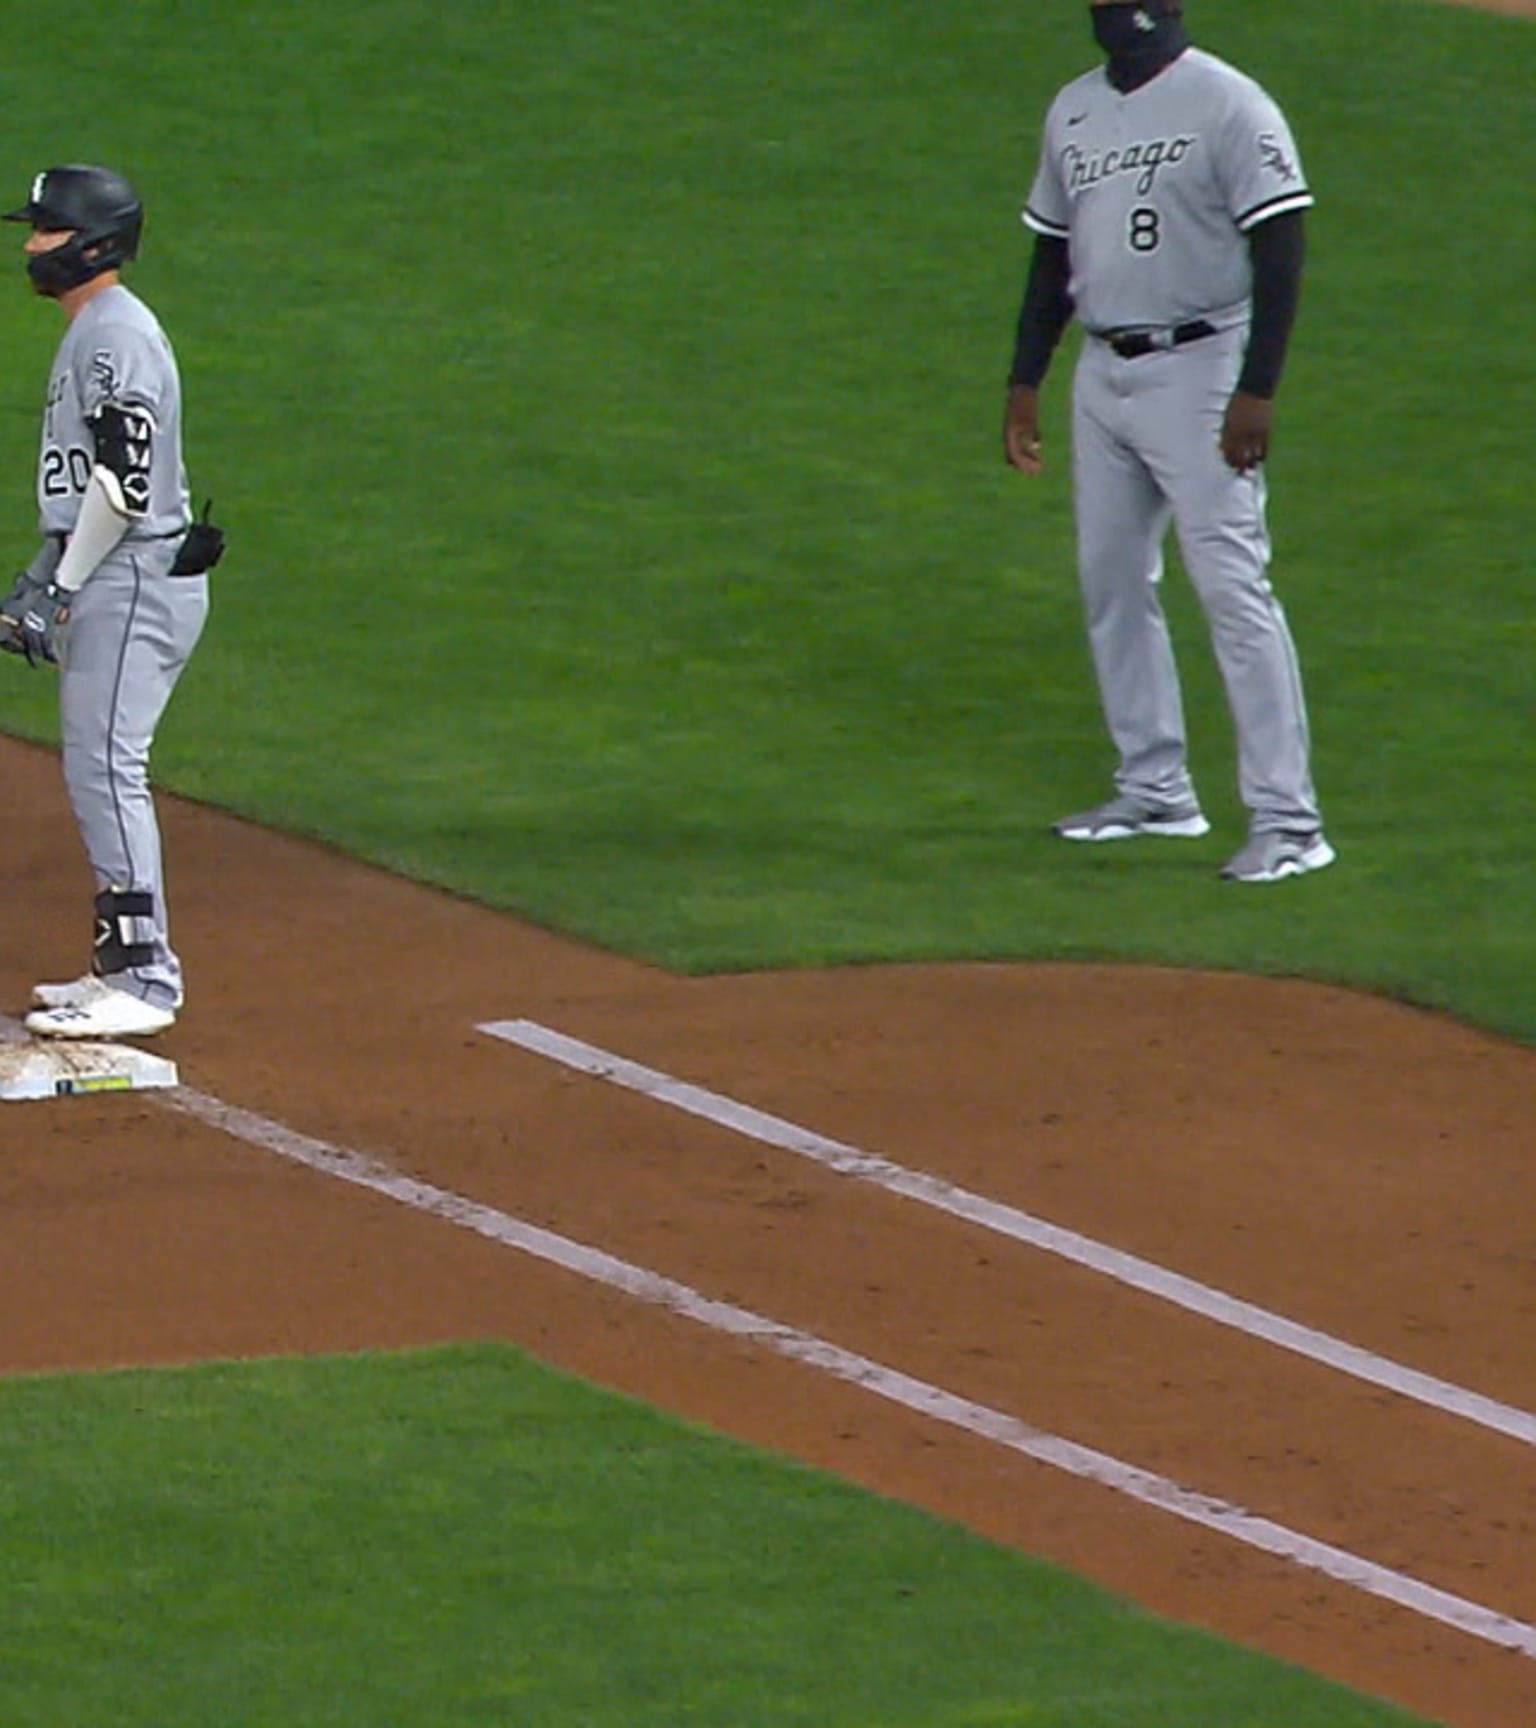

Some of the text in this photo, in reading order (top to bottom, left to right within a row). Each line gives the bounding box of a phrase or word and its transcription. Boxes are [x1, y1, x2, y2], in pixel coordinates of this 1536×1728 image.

[1059, 136, 1198, 198] Chicago
[1129, 207, 1161, 253] 8
[42, 447, 93, 497] 20
